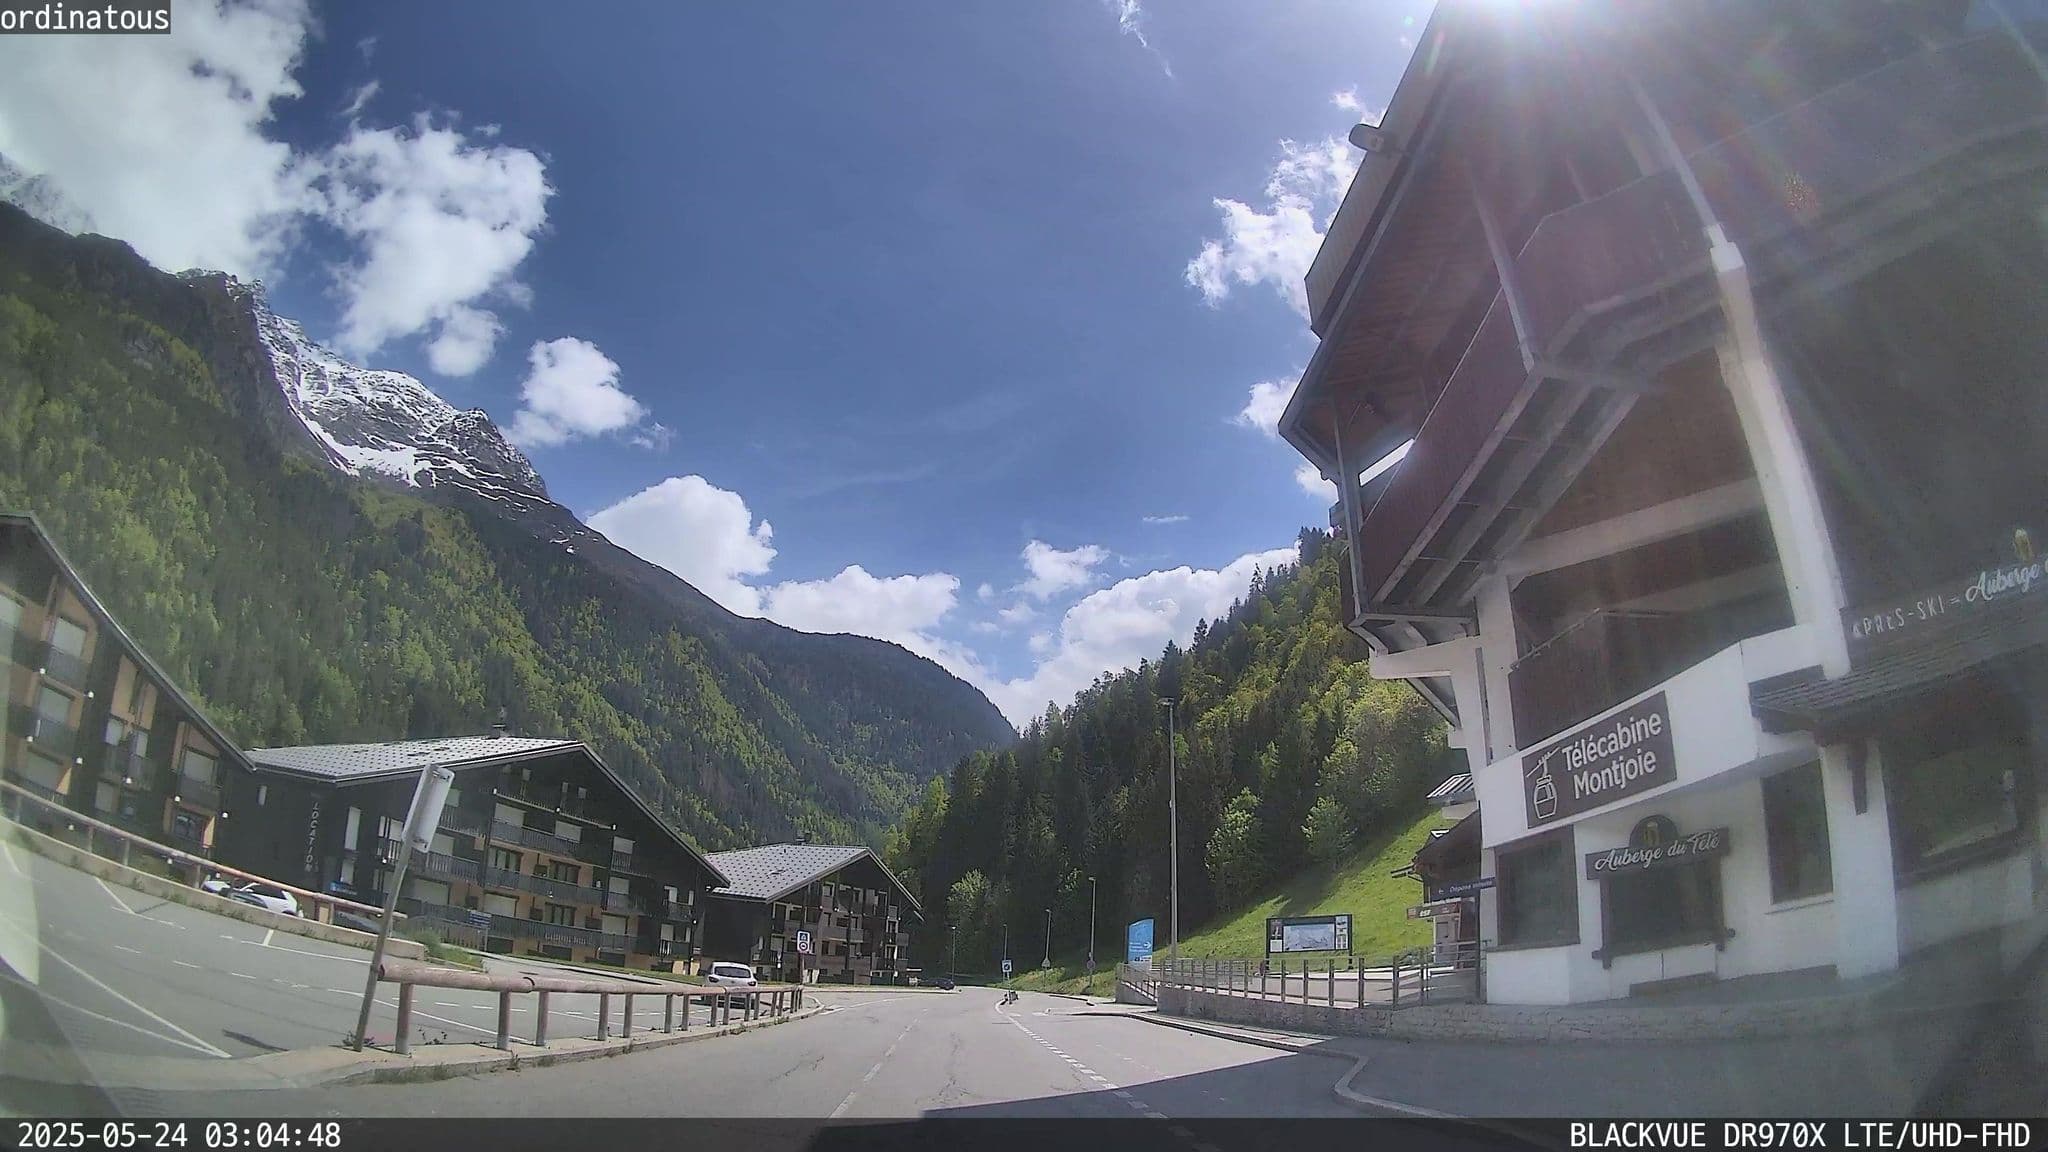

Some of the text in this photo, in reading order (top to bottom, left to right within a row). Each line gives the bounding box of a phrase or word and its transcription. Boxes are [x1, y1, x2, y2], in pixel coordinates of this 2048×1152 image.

[1965, 563, 2041, 603] Auberge
[1562, 713, 1662, 772] Télécabine
[1573, 748, 1657, 800] Montjoie
[1594, 826, 1721, 872] Auberge du Télé
